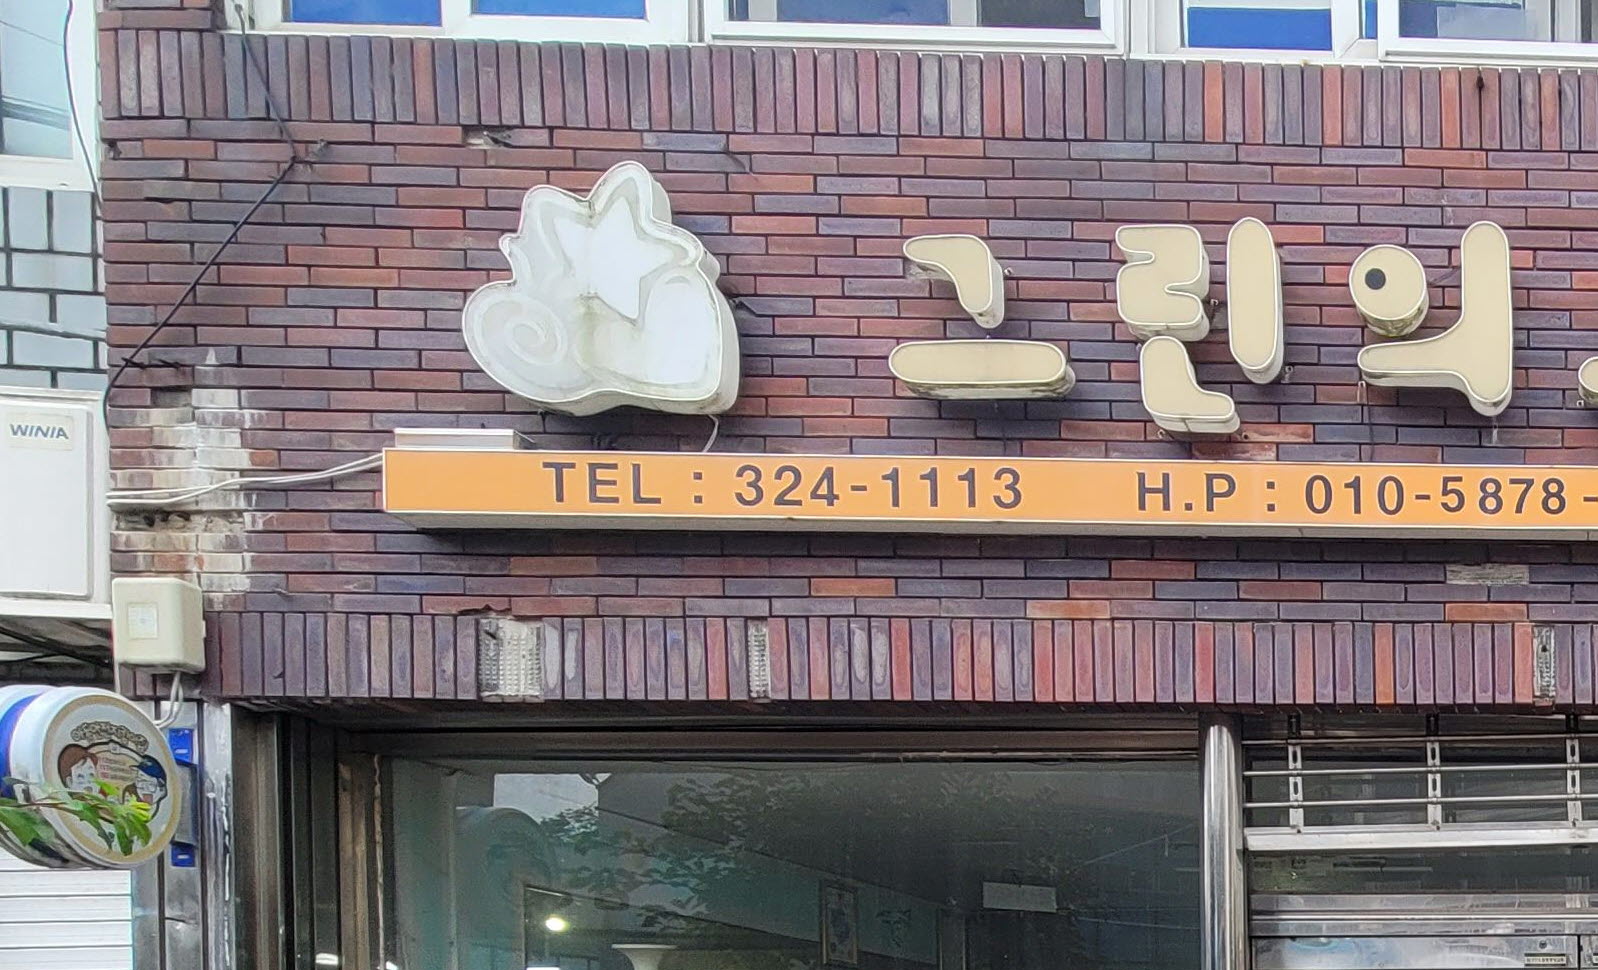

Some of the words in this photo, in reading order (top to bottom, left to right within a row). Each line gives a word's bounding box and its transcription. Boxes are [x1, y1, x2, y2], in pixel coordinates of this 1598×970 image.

[9, 423, 69, 440] WINIA
[542, 461, 663, 505] TEL
[734, 464, 1022, 510] 324-1113
[1136, 470, 1236, 514] H.P
